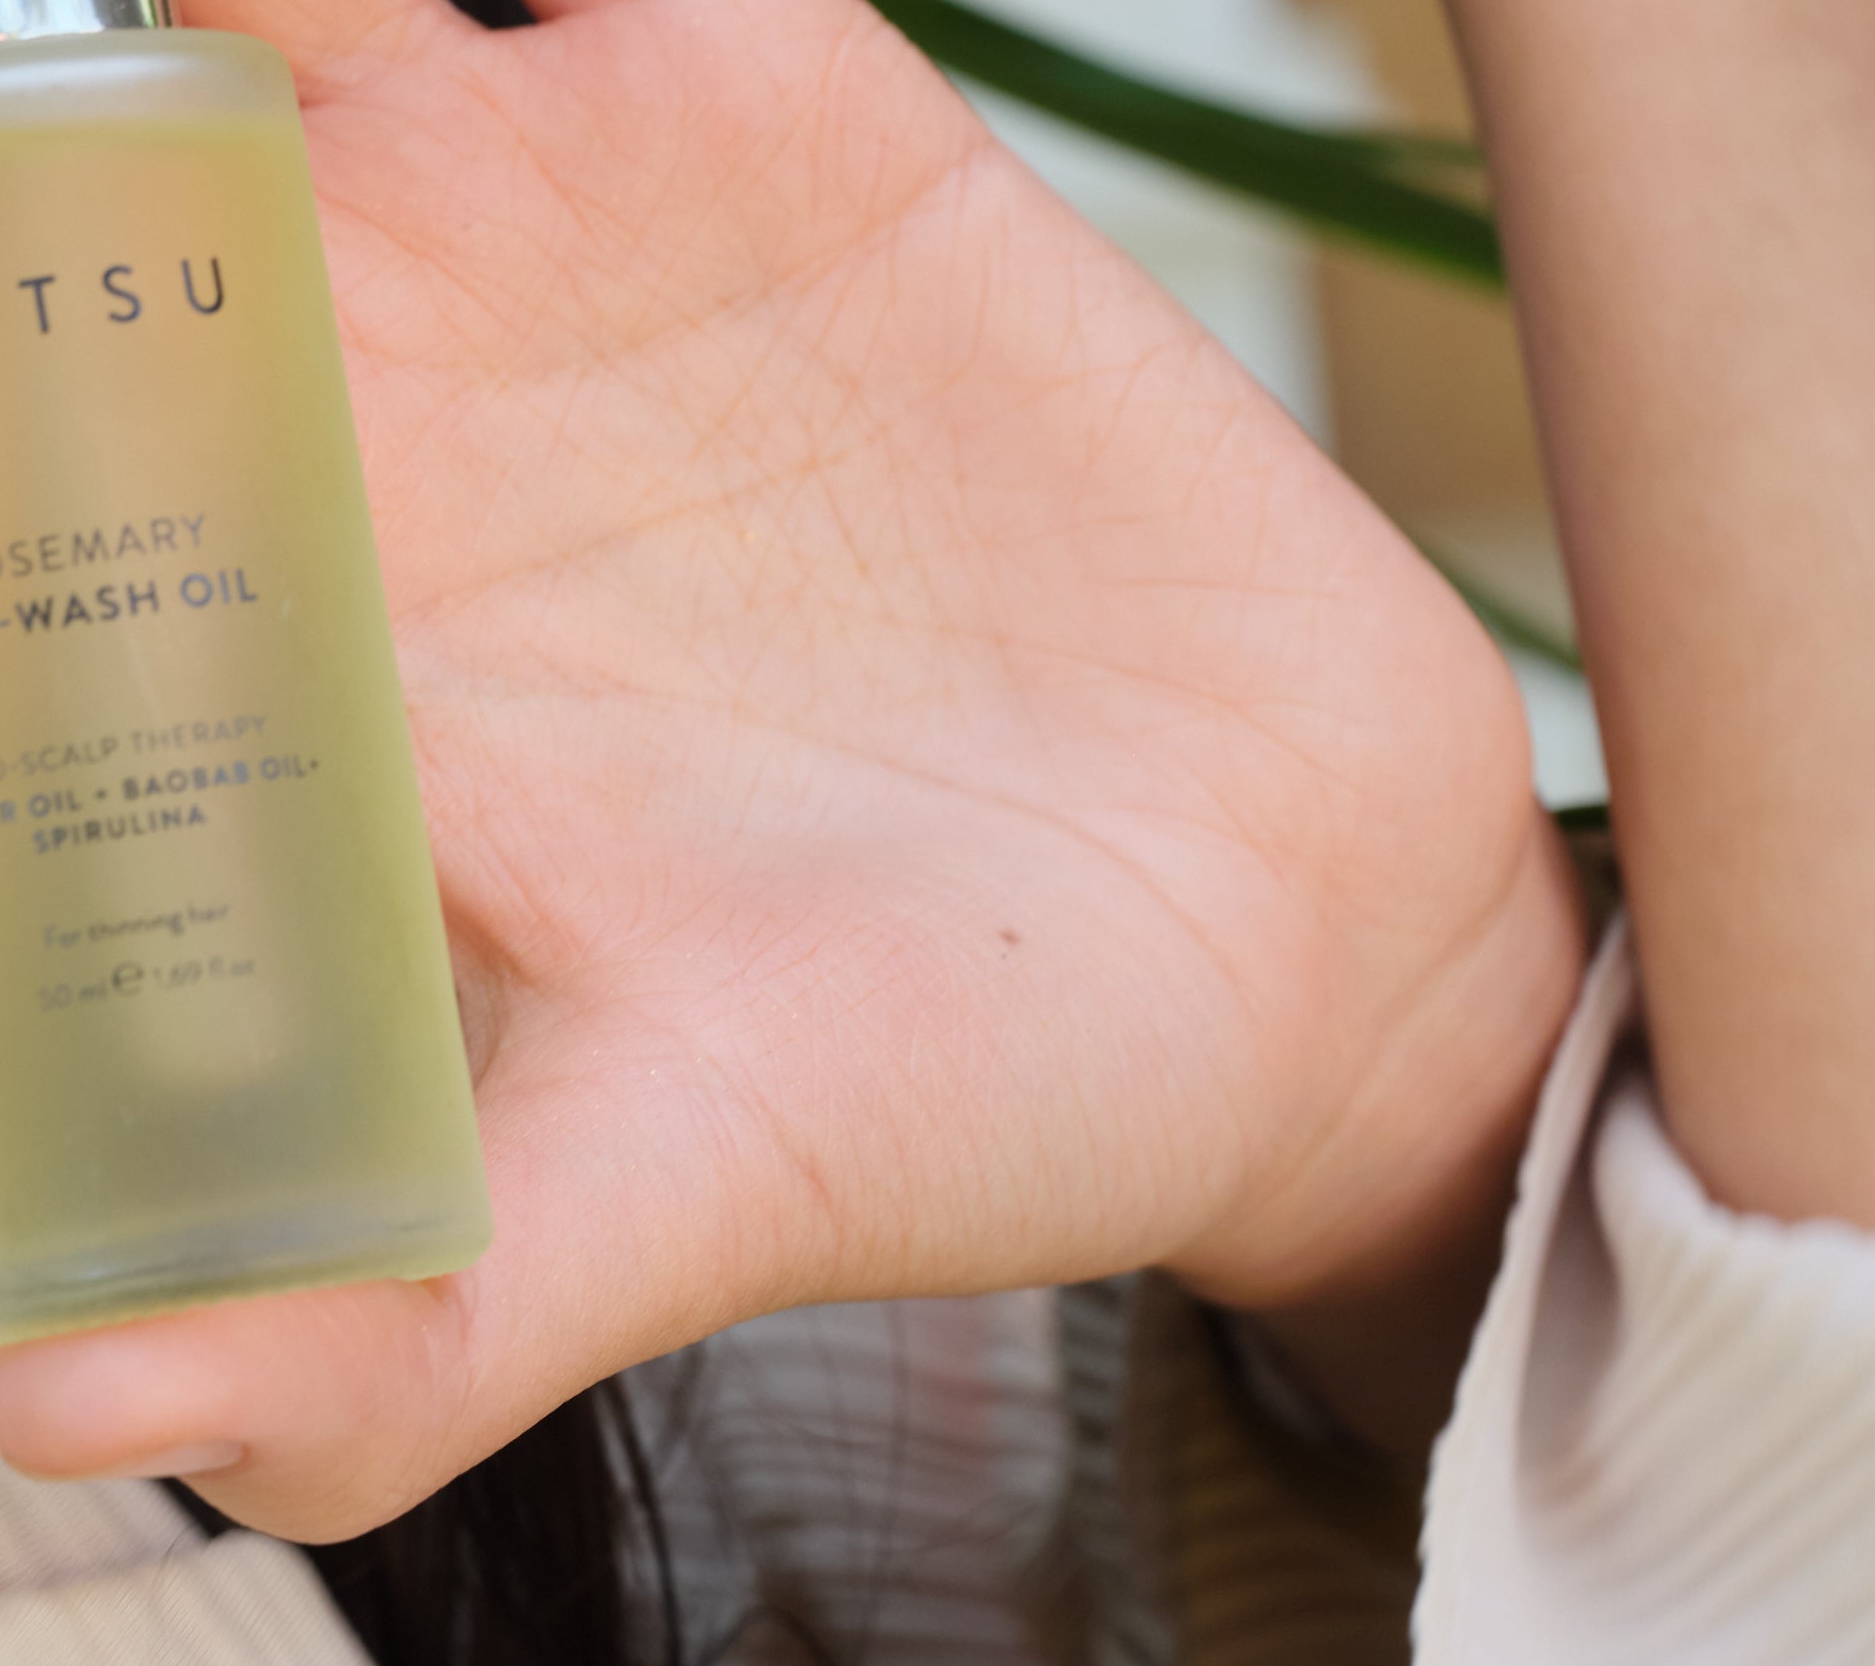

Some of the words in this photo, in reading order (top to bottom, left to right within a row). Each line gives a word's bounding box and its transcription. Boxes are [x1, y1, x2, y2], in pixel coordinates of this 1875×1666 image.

[180, 568, 259, 609] OIL
[131, 715, 267, 755] THERAPY
[28, 788, 83, 819] OIL
[121, 759, 251, 801] BAOBAB
[32, 804, 207, 855] SPIRULINA
